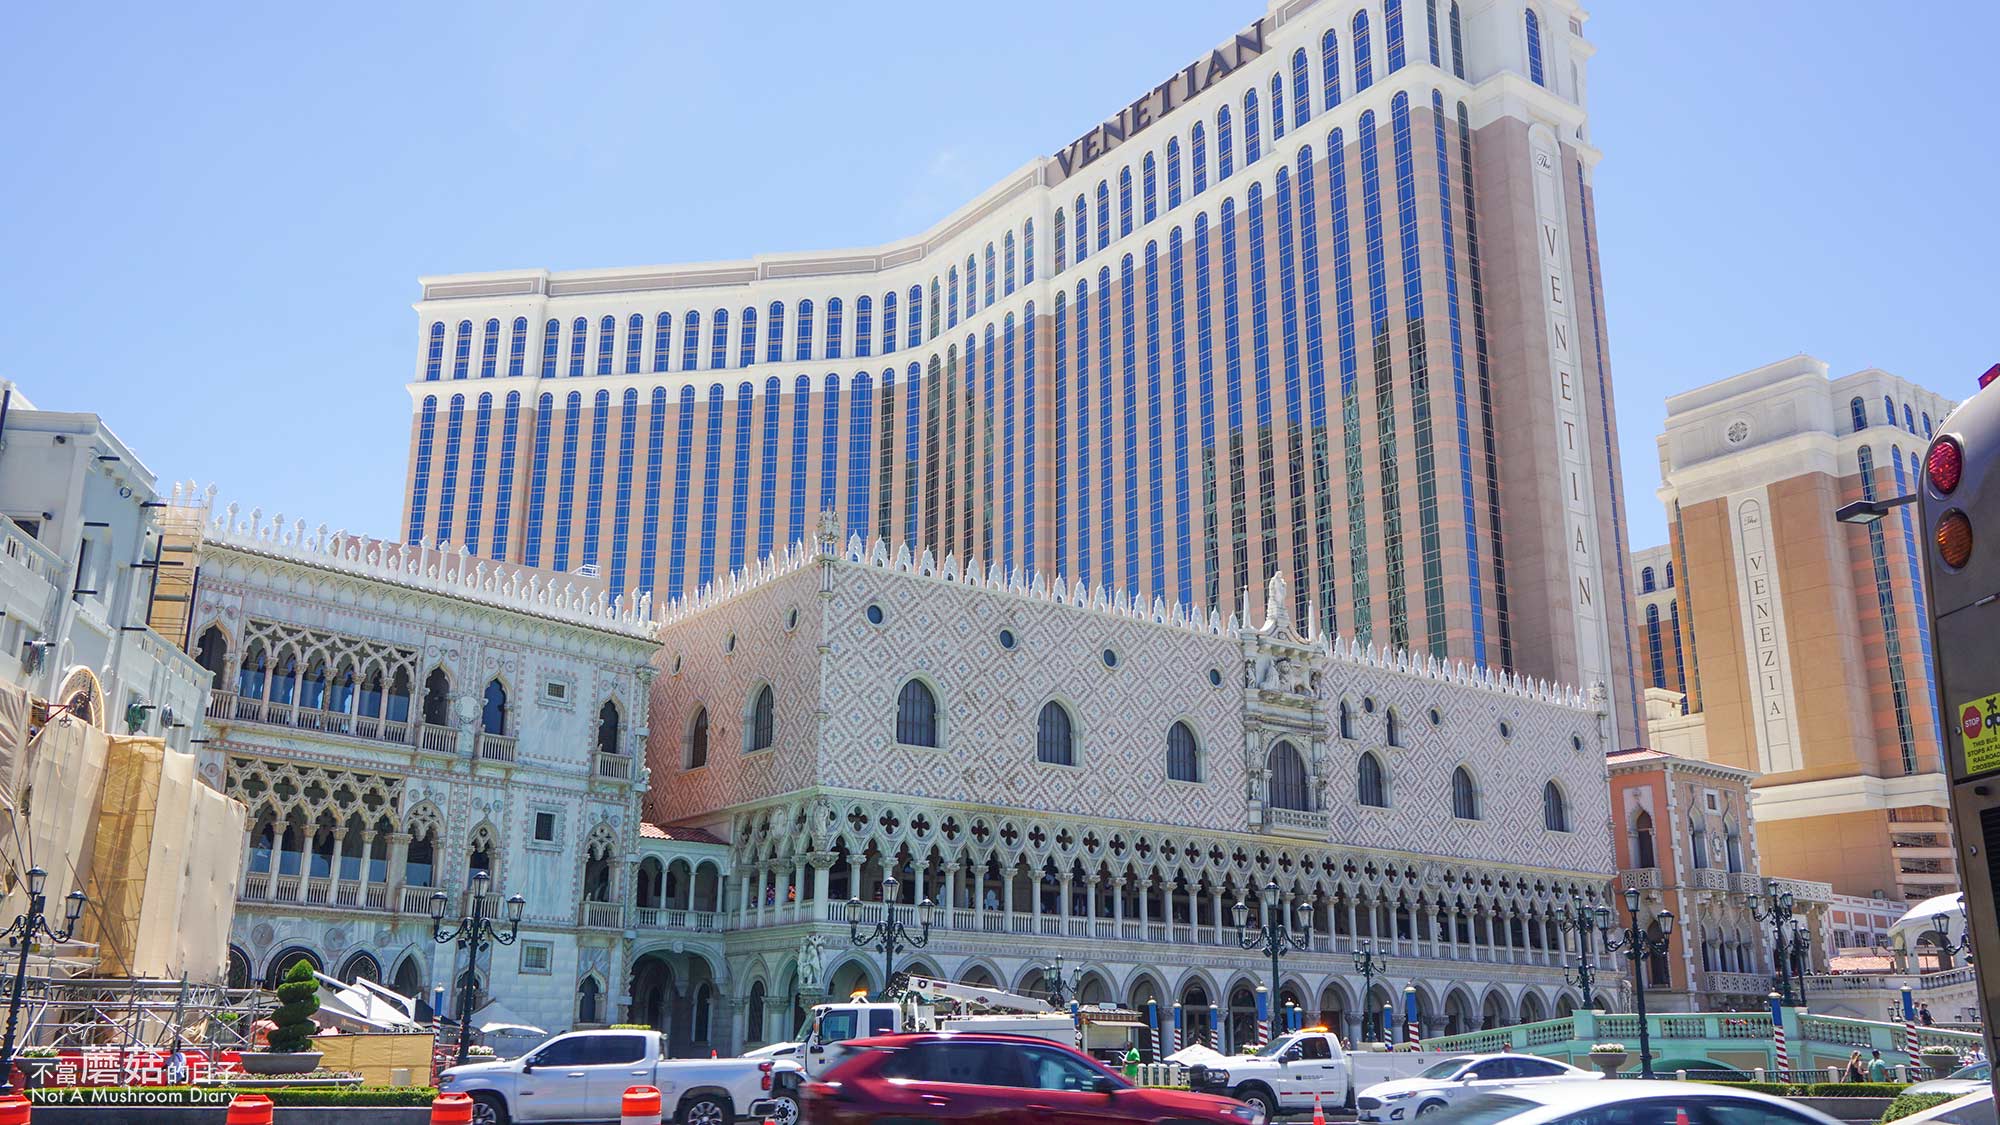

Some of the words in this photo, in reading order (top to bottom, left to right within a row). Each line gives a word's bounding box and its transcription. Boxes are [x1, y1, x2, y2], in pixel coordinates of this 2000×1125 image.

[1054, 18, 1265, 179] VENETIAN
[1536, 153, 1551, 169] The
[1543, 224, 1592, 608] VENETIAN
[1750, 556, 1781, 715] VENEZIA
[1964, 717, 1980, 728] STOP
[1986, 736, 1997, 744] BUS
[1967, 748, 1985, 757] STOPS
